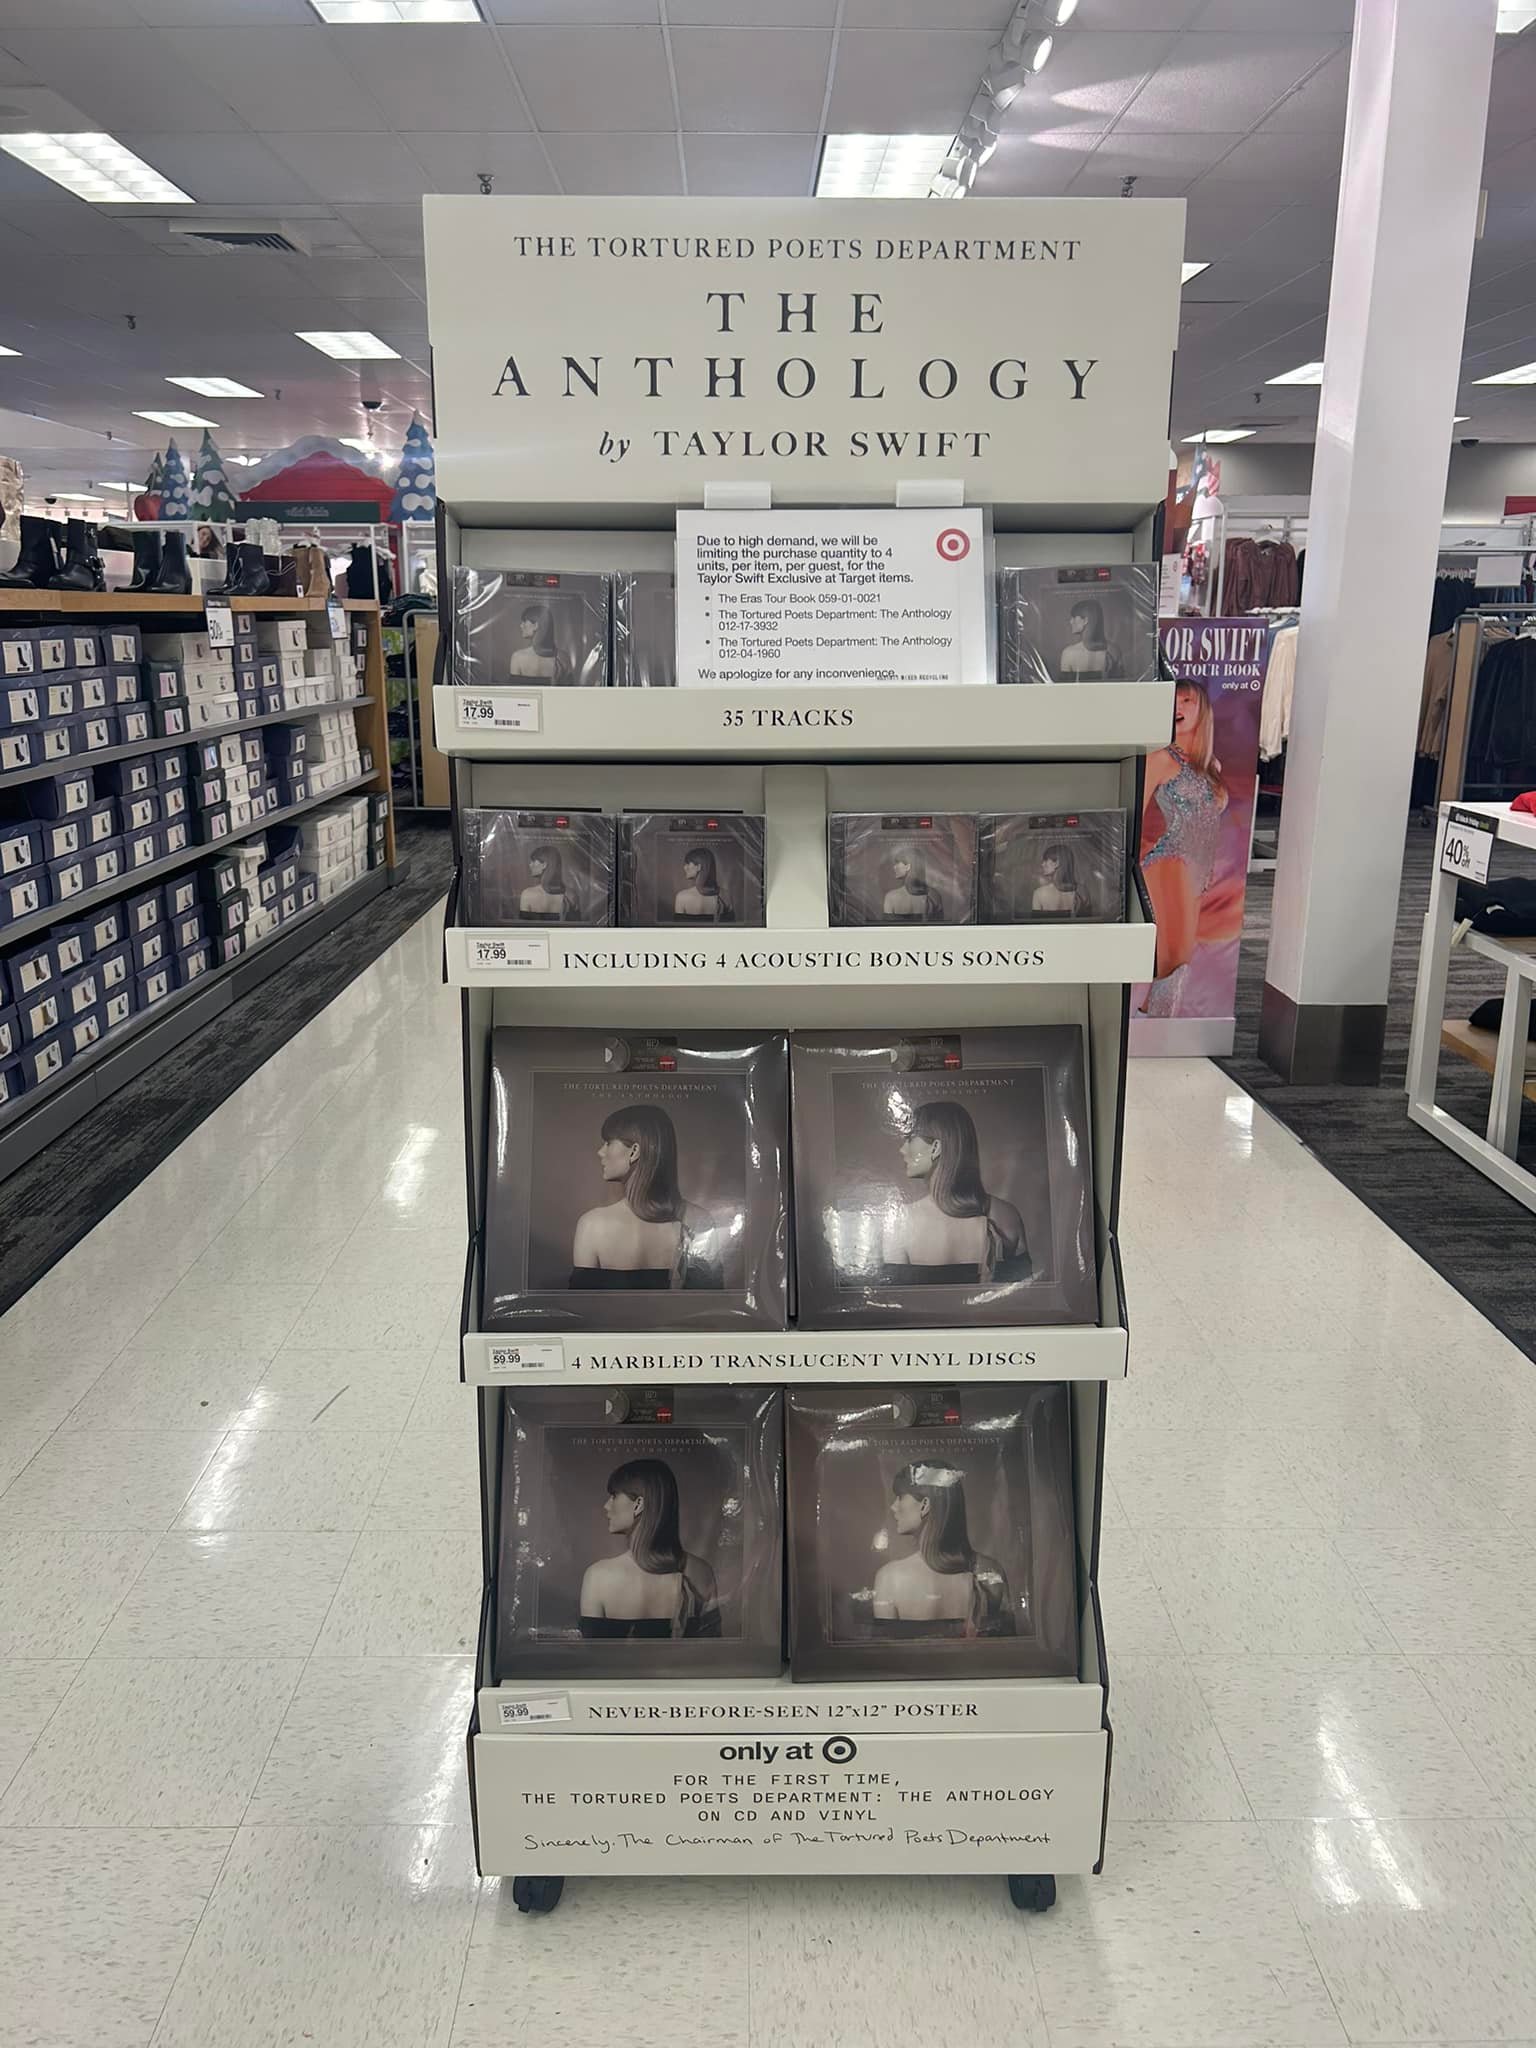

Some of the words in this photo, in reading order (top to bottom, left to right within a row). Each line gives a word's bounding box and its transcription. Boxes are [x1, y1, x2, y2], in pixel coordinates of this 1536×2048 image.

[514, 237, 575, 256] THE
[587, 238, 754, 257] TORTURED
[769, 239, 861, 259] POETS
[876, 240, 1080, 260] DEPARTMENT
[707, 293, 883, 333] THE
[492, 356, 1098, 399] ANTHOLOGY
[599, 431, 630, 463] by
[654, 432, 828, 456] TAYLOR
[851, 432, 990, 457] SWIFT
[697, 536, 720, 545] Due
[724, 536, 735, 546] to
[739, 536, 763, 548] high
[767, 536, 817, 547] demand,
[841, 536, 859, 545] will
[863, 536, 877, 545] be
[697, 548, 738, 560] limiting
[742, 548, 760, 558] the
[764, 548, 817, 560] purchase
[821, 548, 867, 560] quantity
[871, 549, 882, 557] to
[886, 548, 892, 557] 4
[697, 561, 728, 572] units,
[732, 560, 751, 572] per
[755, 560, 782, 572] item,
[786, 563, 805, 572] per
[808, 561, 843, 572] guest,
[848, 560, 863, 570] for
[867, 560, 884, 570] the
[697, 573, 732, 586] Taylor
[735, 572, 764, 583] Swift
[768, 572, 822, 583] Exclusive
[825, 574, 836, 583] at
[839, 573, 875, 585] Target
[879, 572, 913, 583] items.
[718, 594, 737, 603] The
[741, 594, 762, 603] Eras
[765, 594, 786, 603] Tour
[790, 594, 815, 603] Book
[819, 593, 880, 603] 059-01-0021
[719, 610, 737, 619] The
[740, 610, 781, 619] Tortured
[785, 610, 813, 619] Poets
[816, 610, 877, 621] Department:
[880, 609, 899, 618] The
[901, 609, 952, 620] Anthology
[719, 621, 778, 630] 012-17-3932
[719, 637, 738, 647] The
[740, 638, 782, 646] Tortured
[785, 637, 813, 646] Poets
[816, 637, 877, 648] Department:
[880, 637, 899, 645] The
[902, 636, 952, 647] Anthology
[1200, 627, 1265, 662] SWIFT
[719, 649, 780, 658] 012-04-1960
[698, 669, 716, 679] We
[719, 669, 772, 681] apologize
[776, 669, 790, 678] for
[793, 671, 813, 680] any
[816, 668, 898, 680] inconvenience.
[1183, 663, 1219, 677] TOUR
[1223, 663, 1261, 677] BOOK
[1222, 682, 1239, 691] only
[463, 707, 494, 718] 17.99
[723, 710, 743, 726] 35
[752, 710, 852, 726] TRACKS
[477, 949, 506, 959] 17.99
[564, 954, 705, 968] INCLUDING
[716, 954, 725, 967] 4
[736, 953, 860, 968] ACOUSTIC
[871, 952, 953, 967] BONUS
[963, 951, 1043, 965] SONGS
[493, 1354, 521, 1364] 59.99
[572, 1357, 580, 1369] 4
[591, 1356, 702, 1369] MARBLED
[711, 1354, 883, 1367] TRANSLUCENT
[891, 1353, 960, 1366] VINYL
[970, 1352, 1035, 1365] DISCS
[503, 1708, 529, 1718] 59.99
[590, 1706, 818, 1718] NEVER-BEFORE-SEEN
[896, 1704, 978, 1716] POSTER
[720, 1742, 779, 1764] only
[786, 1742, 813, 1759] at
[674, 1775, 708, 1785] FOR
[722, 1775, 756, 1785] THE
[772, 1774, 829, 1785] FIRST
[844, 1774, 898, 1786] TIME,
[522, 1793, 555, 1804] THE
[570, 1793, 665, 1804] TORTURED
[681, 1793, 738, 1803] POETS
[754, 1792, 880, 1803] DEPARTMENT:
[898, 1791, 931, 1802] THE
[946, 1789, 1054, 1801] ANTHOLOGY
[698, 1811, 719, 1821] ON
[735, 1811, 756, 1821] CD
[771, 1810, 805, 1820] AND
[819, 1810, 876, 1820] VINYL
[618, 1833, 653, 1848] The
[666, 1834, 752, 1845] Chairman
[763, 1833, 783, 1844] of
[790, 1832, 823, 1843] The
[824, 1828, 894, 1842] Tortured
[904, 1830, 942, 1844] Poets
[946, 1829, 1050, 1847] Department
